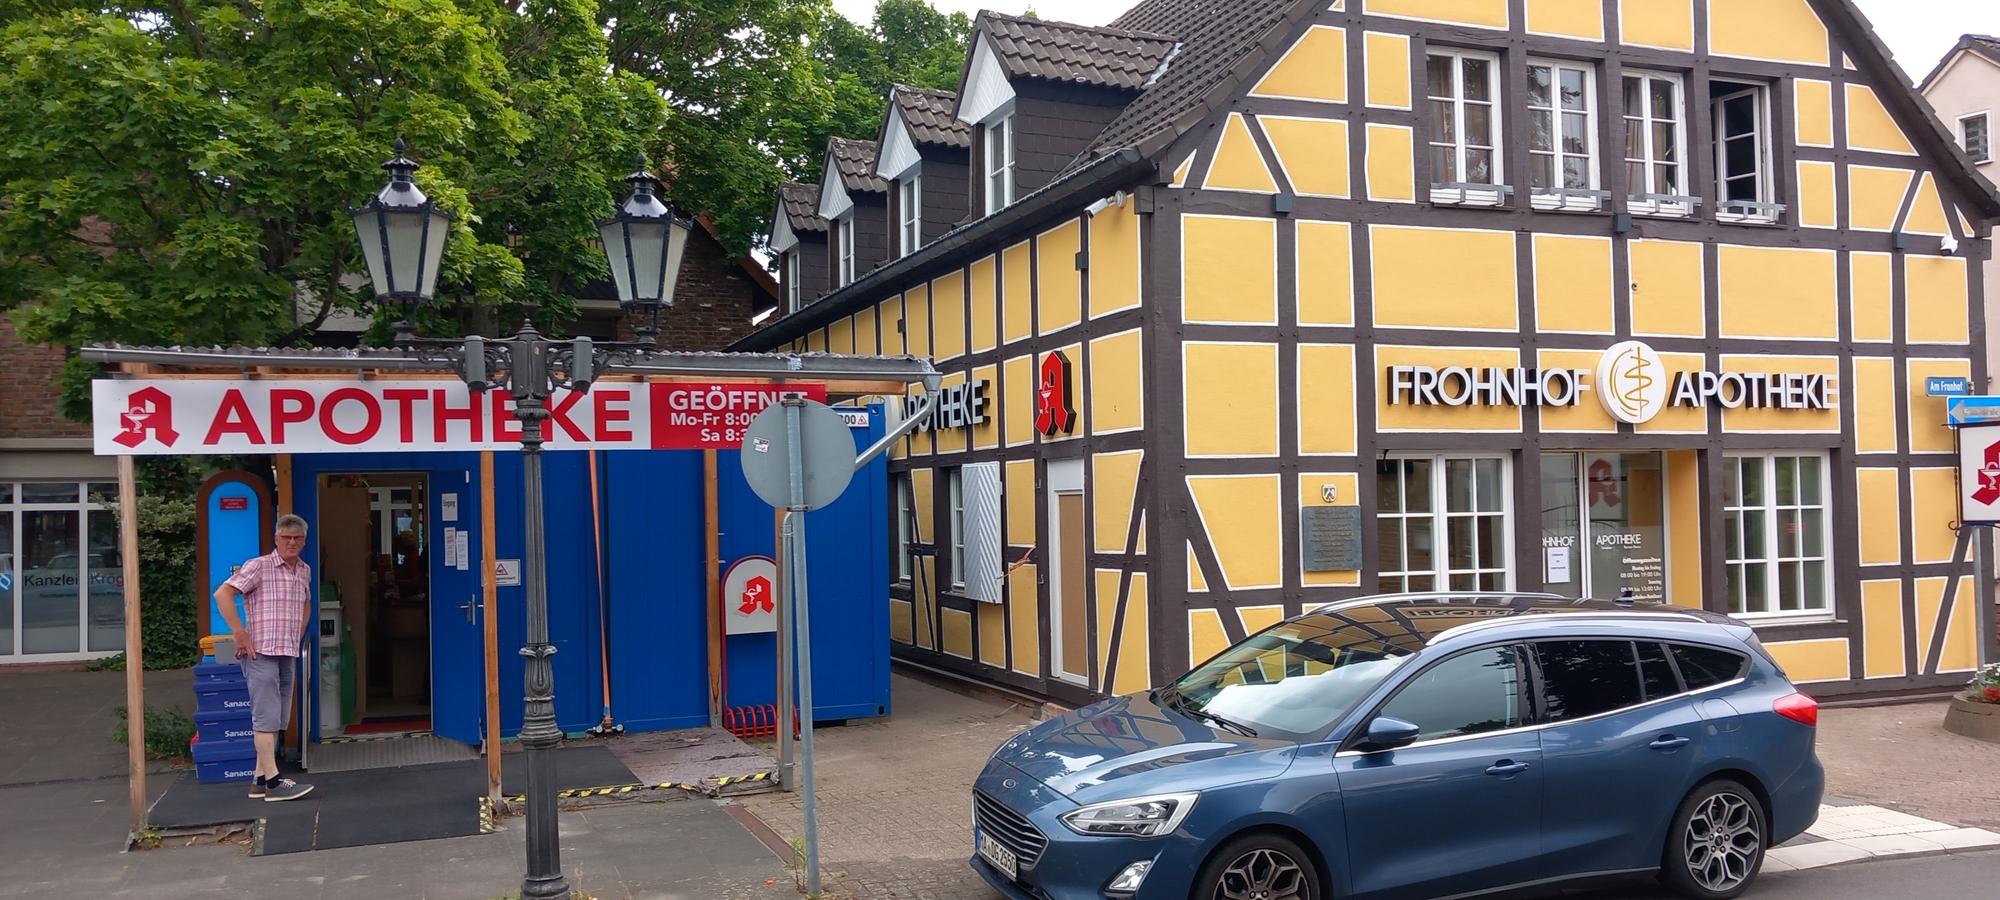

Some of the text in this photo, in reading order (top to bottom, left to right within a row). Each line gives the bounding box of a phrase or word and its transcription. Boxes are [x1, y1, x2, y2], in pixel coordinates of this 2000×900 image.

[1389, 366, 1838, 409] FROHNHOF APOTHEKE
[1930, 381, 1940, 391] Am
[203, 388, 633, 446] APOTHEKE
[671, 413, 720, 426] Mo-Fr
[701, 429, 746, 442] Sa 8:3
[1542, 534, 1642, 547] HNHOF APOTHEKE
[24, 574, 78, 586] Kanzlei
[224, 700, 251, 708] Sanaco
[224, 730, 254, 738] Sanaco
[224, 770, 256, 778] Sanacor
